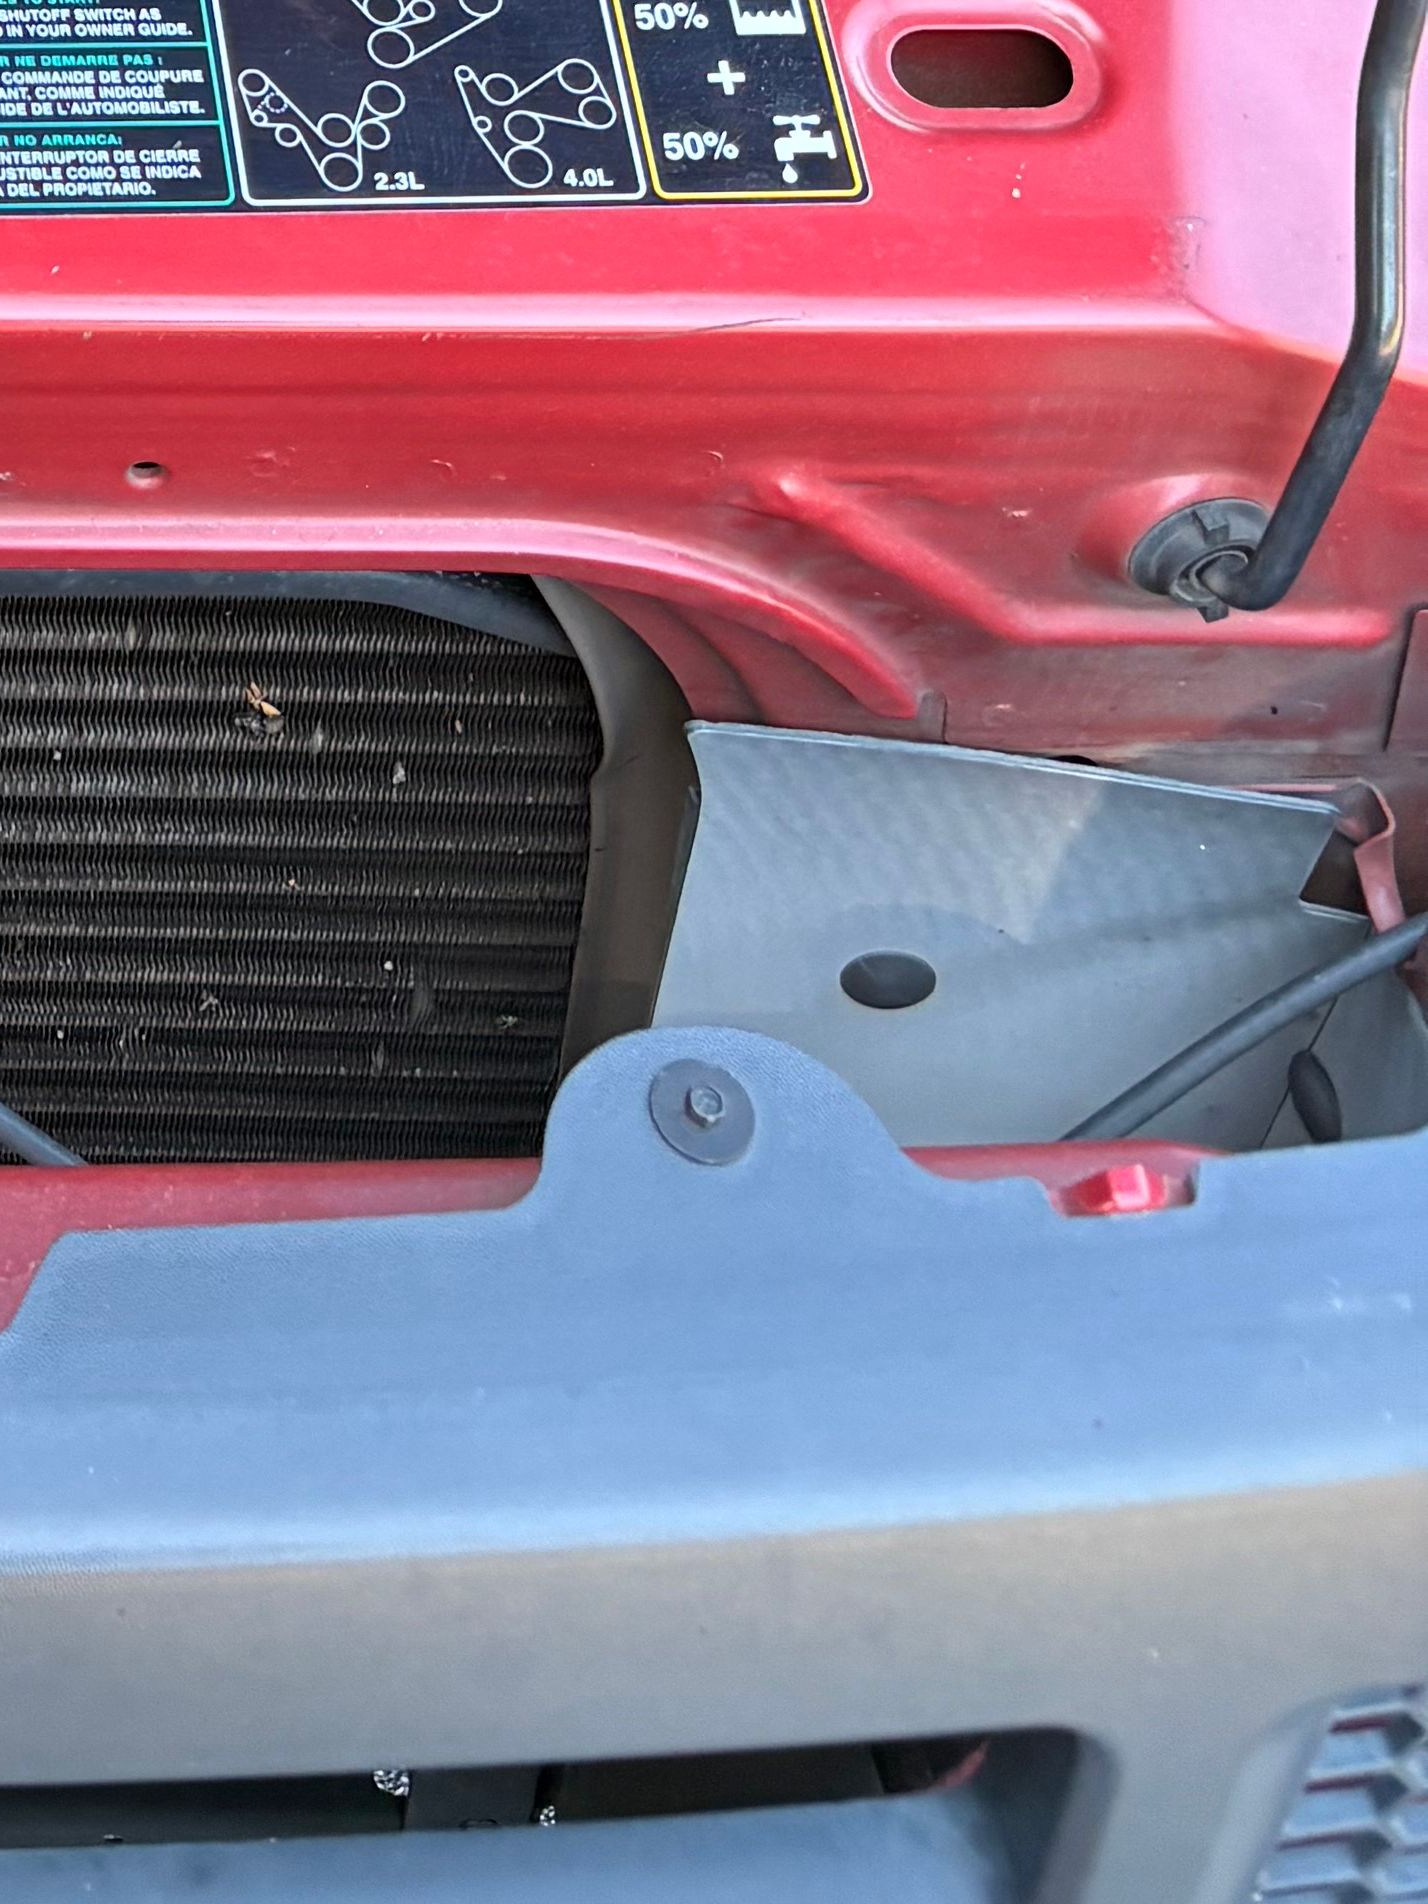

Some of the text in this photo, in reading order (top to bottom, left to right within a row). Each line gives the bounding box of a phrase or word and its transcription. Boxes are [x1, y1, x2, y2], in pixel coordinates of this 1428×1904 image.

[74, 8, 136, 21] SWITCH
[139, 8, 161, 20] AS
[634, 2, 709, 30] 50%
[6, 24, 23, 37] IN
[26, 23, 71, 37] YOUR
[75, 23, 135, 36] OWNER
[138, 22, 192, 36] GUIDE.
[662, 131, 739, 160] 50%
[374, 173, 425, 190] 2.3L
[564, 169, 614, 187] 4.0L
